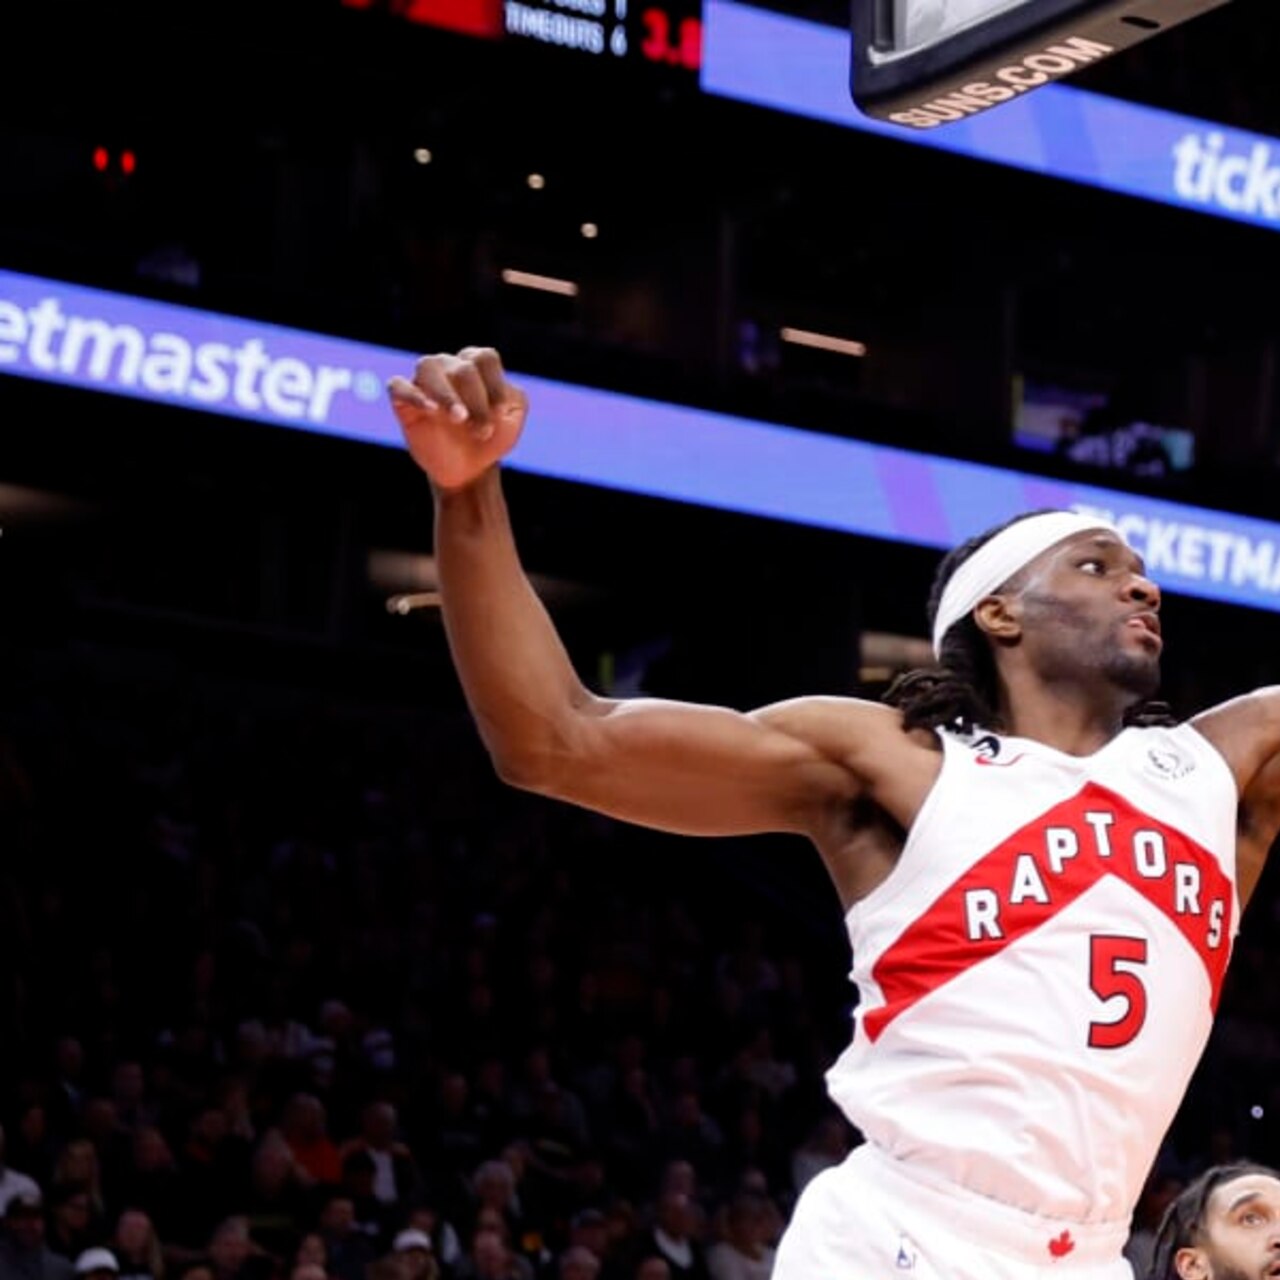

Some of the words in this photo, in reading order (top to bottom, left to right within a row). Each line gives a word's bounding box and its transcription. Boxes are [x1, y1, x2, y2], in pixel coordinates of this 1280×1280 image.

[889, 36, 1114, 127] SUNS.COM
[964, 811, 1224, 949] RAPTORS
[1087, 933, 1149, 1050] 5
